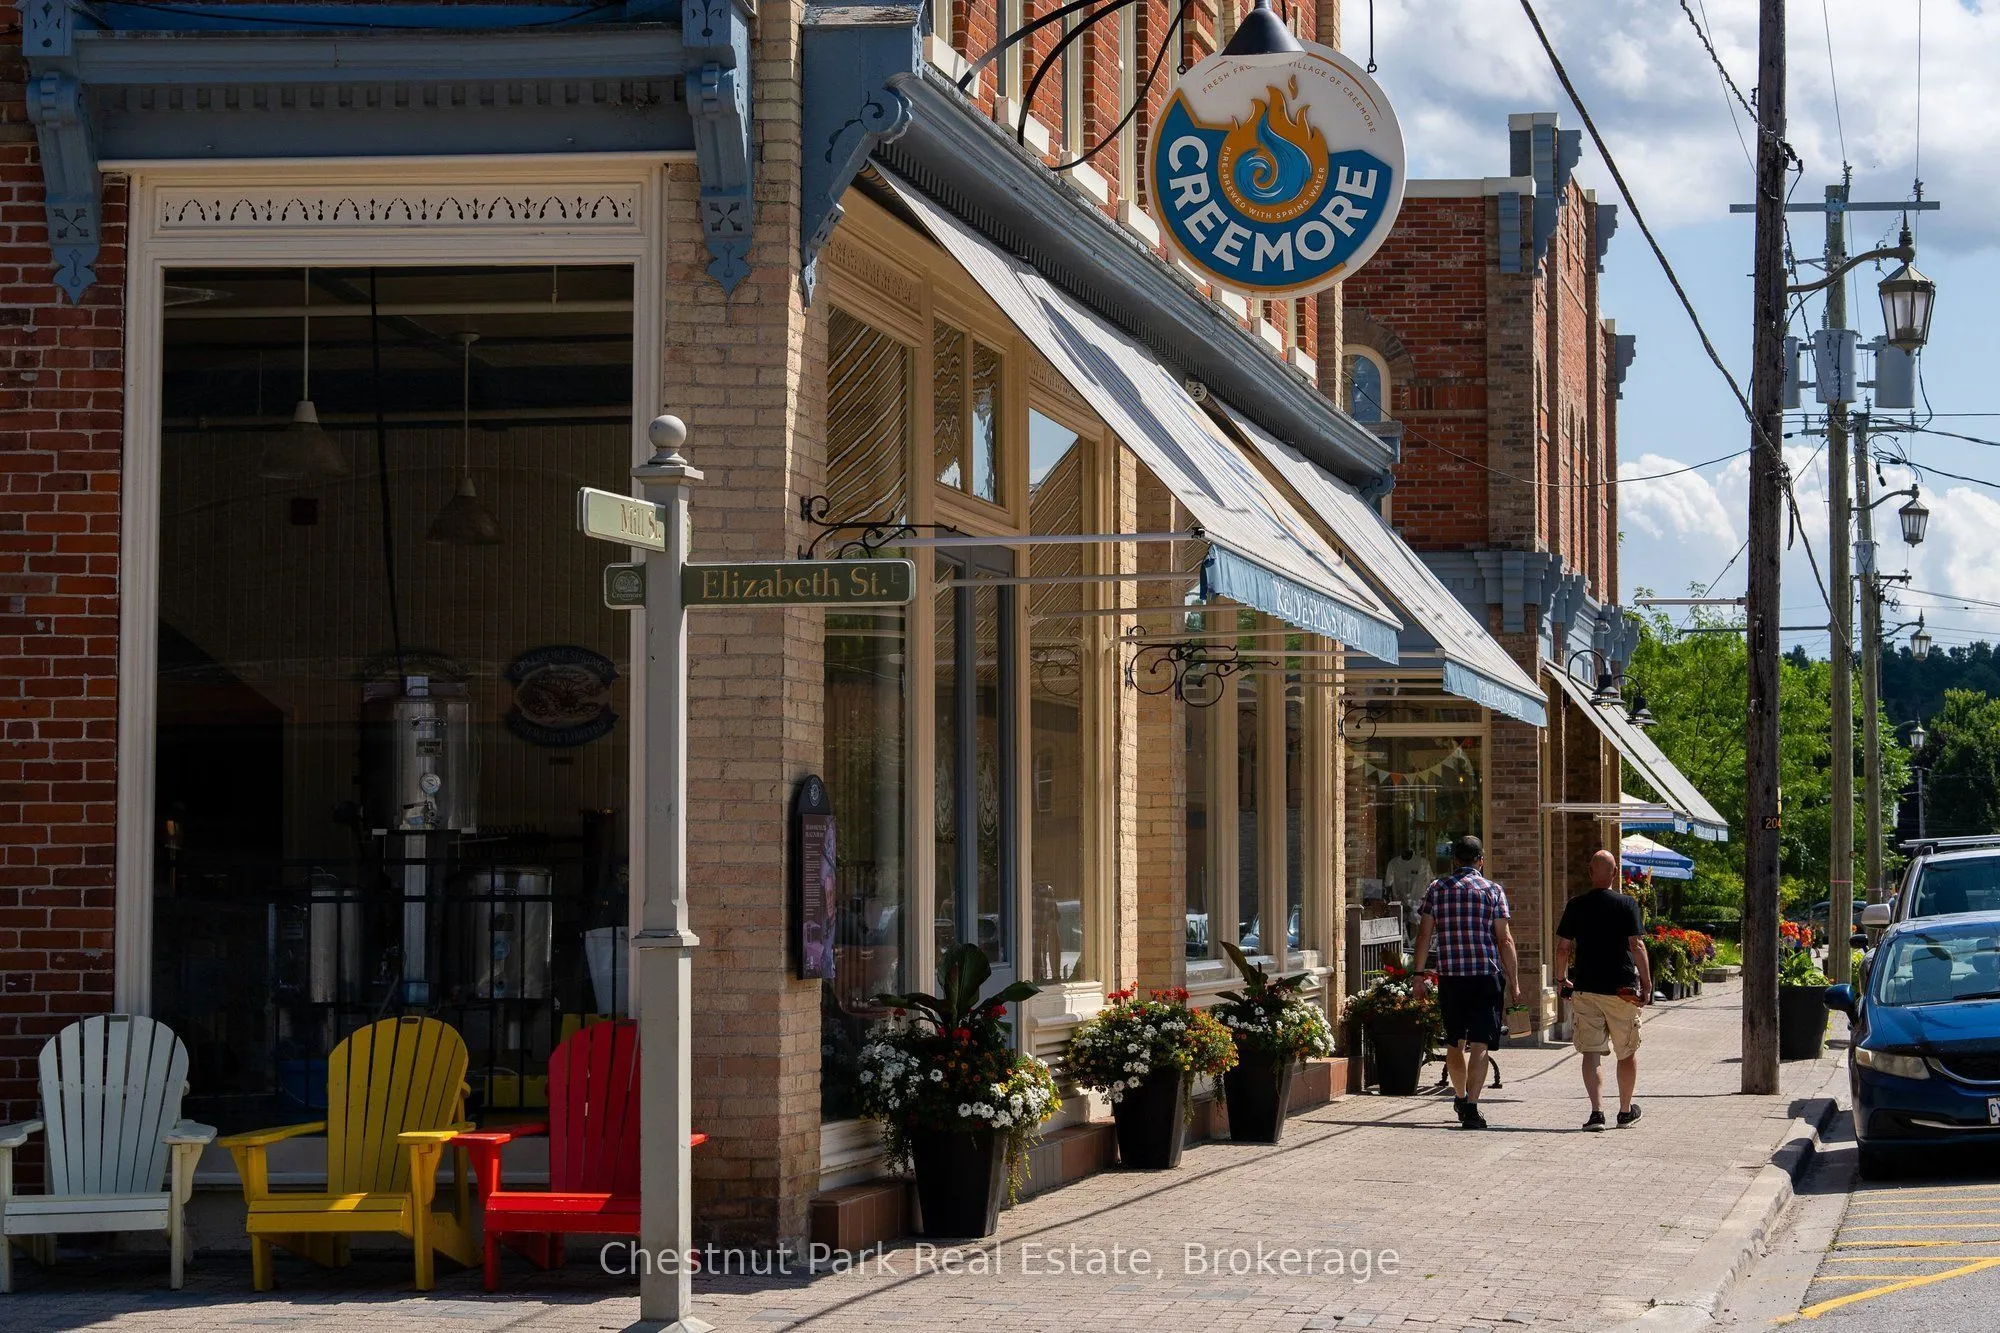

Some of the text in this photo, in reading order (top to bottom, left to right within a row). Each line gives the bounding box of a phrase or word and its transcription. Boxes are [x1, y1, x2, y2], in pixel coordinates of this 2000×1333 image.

[1202, 72, 1230, 94] FRESH
[1329, 76, 1342, 86] OF
[1342, 87, 1376, 133] CREEMORE
[1168, 135, 1378, 272] CREEMORE
[1248, 207, 1272, 218] WITH
[1276, 199, 1310, 219] SPRING
[1308, 167, 1325, 197] WATER
[620, 503, 661, 541] Mill St.
[702, 567, 840, 600] Elizabeth
[850, 567, 888, 597] St.
